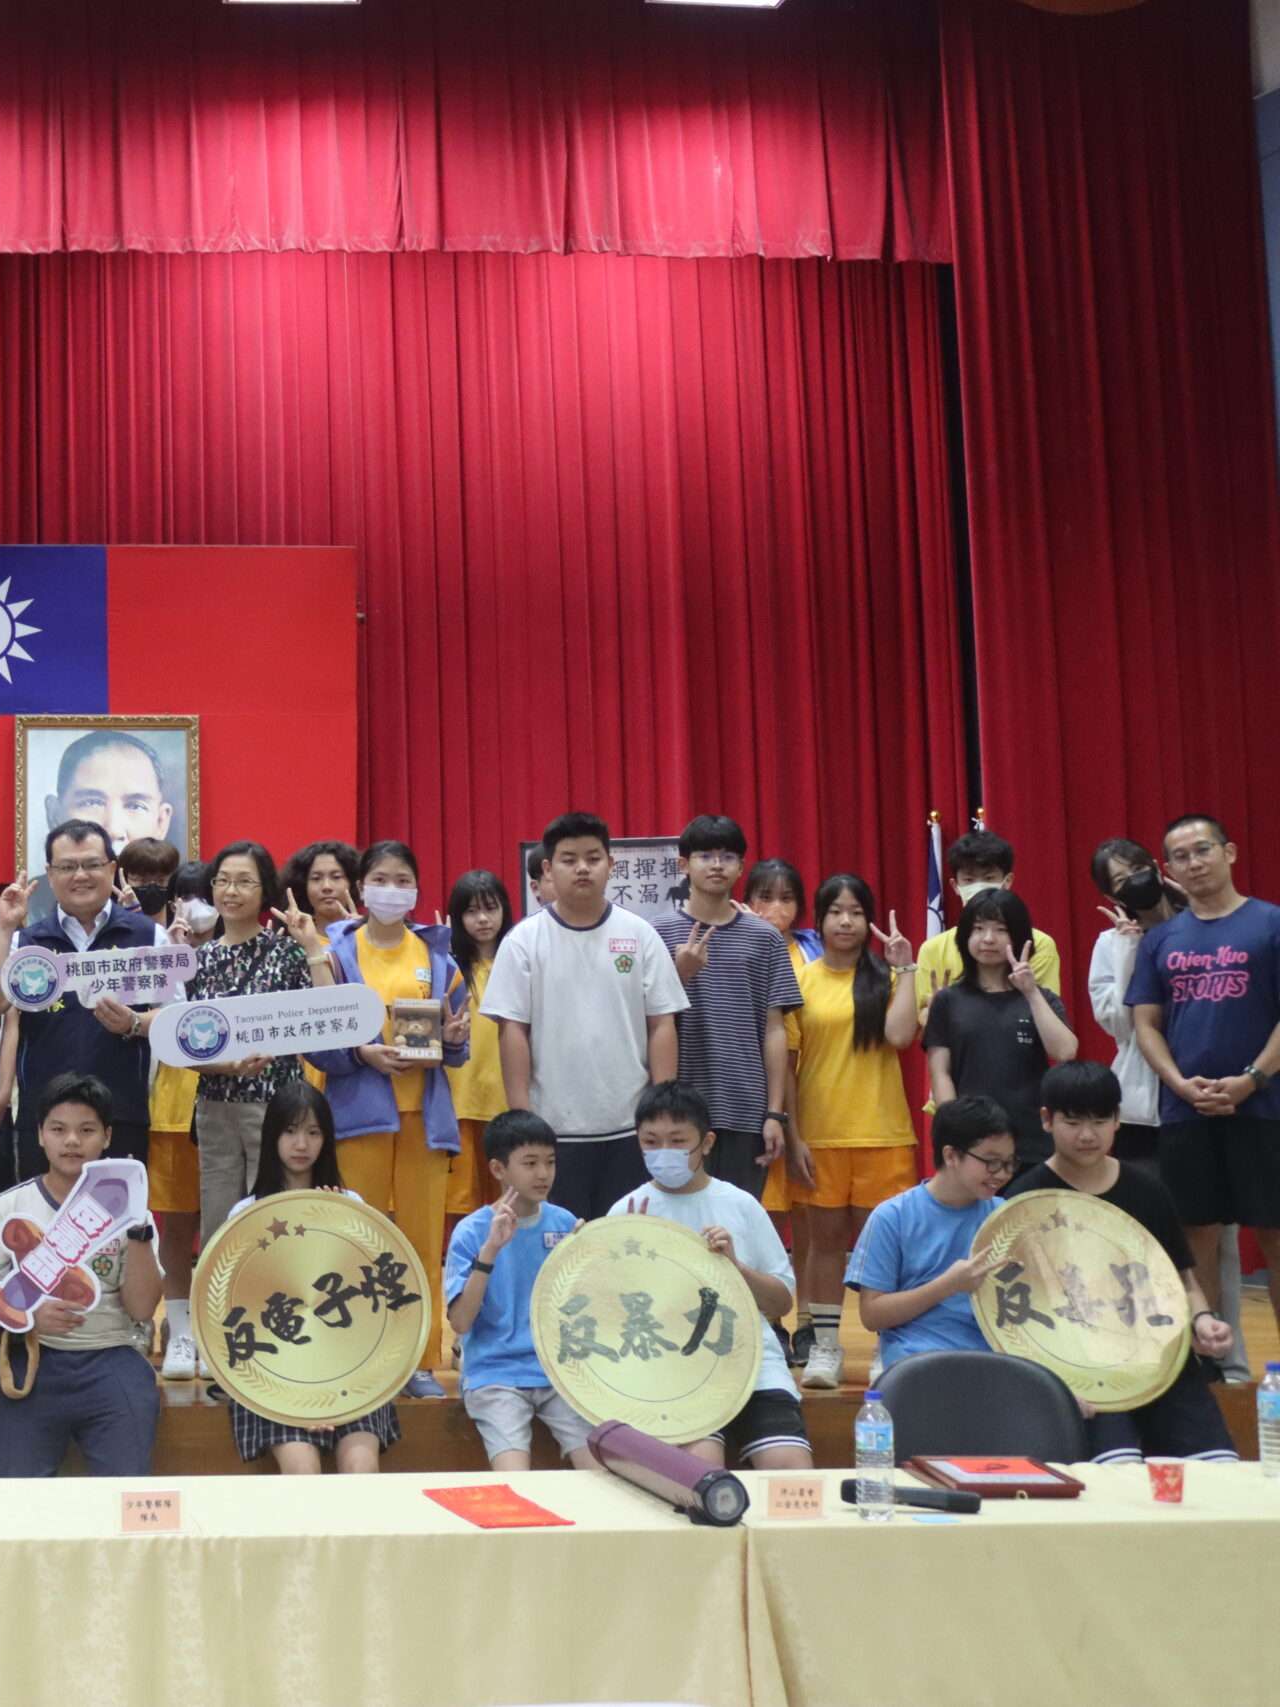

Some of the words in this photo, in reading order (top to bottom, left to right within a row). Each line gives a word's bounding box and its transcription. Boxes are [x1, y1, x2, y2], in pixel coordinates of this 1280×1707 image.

[611, 884, 659, 904] 不漏
[65, 953, 190, 976] 桃園市政府警察局
[1167, 945, 1249, 971] Chien-Kuo
[91, 973, 169, 994] 少年警察隊
[1169, 970, 1250, 1002] SPORTS
[234, 1013, 273, 1024] Taoyuan
[277, 1006, 304, 1018] Police
[308, 1002, 360, 1017] Department
[235, 1016, 359, 1043] 桃園市政府警察局
[222, 1251, 423, 1368] 反電子煙
[557, 1286, 739, 1364] 反暴力
